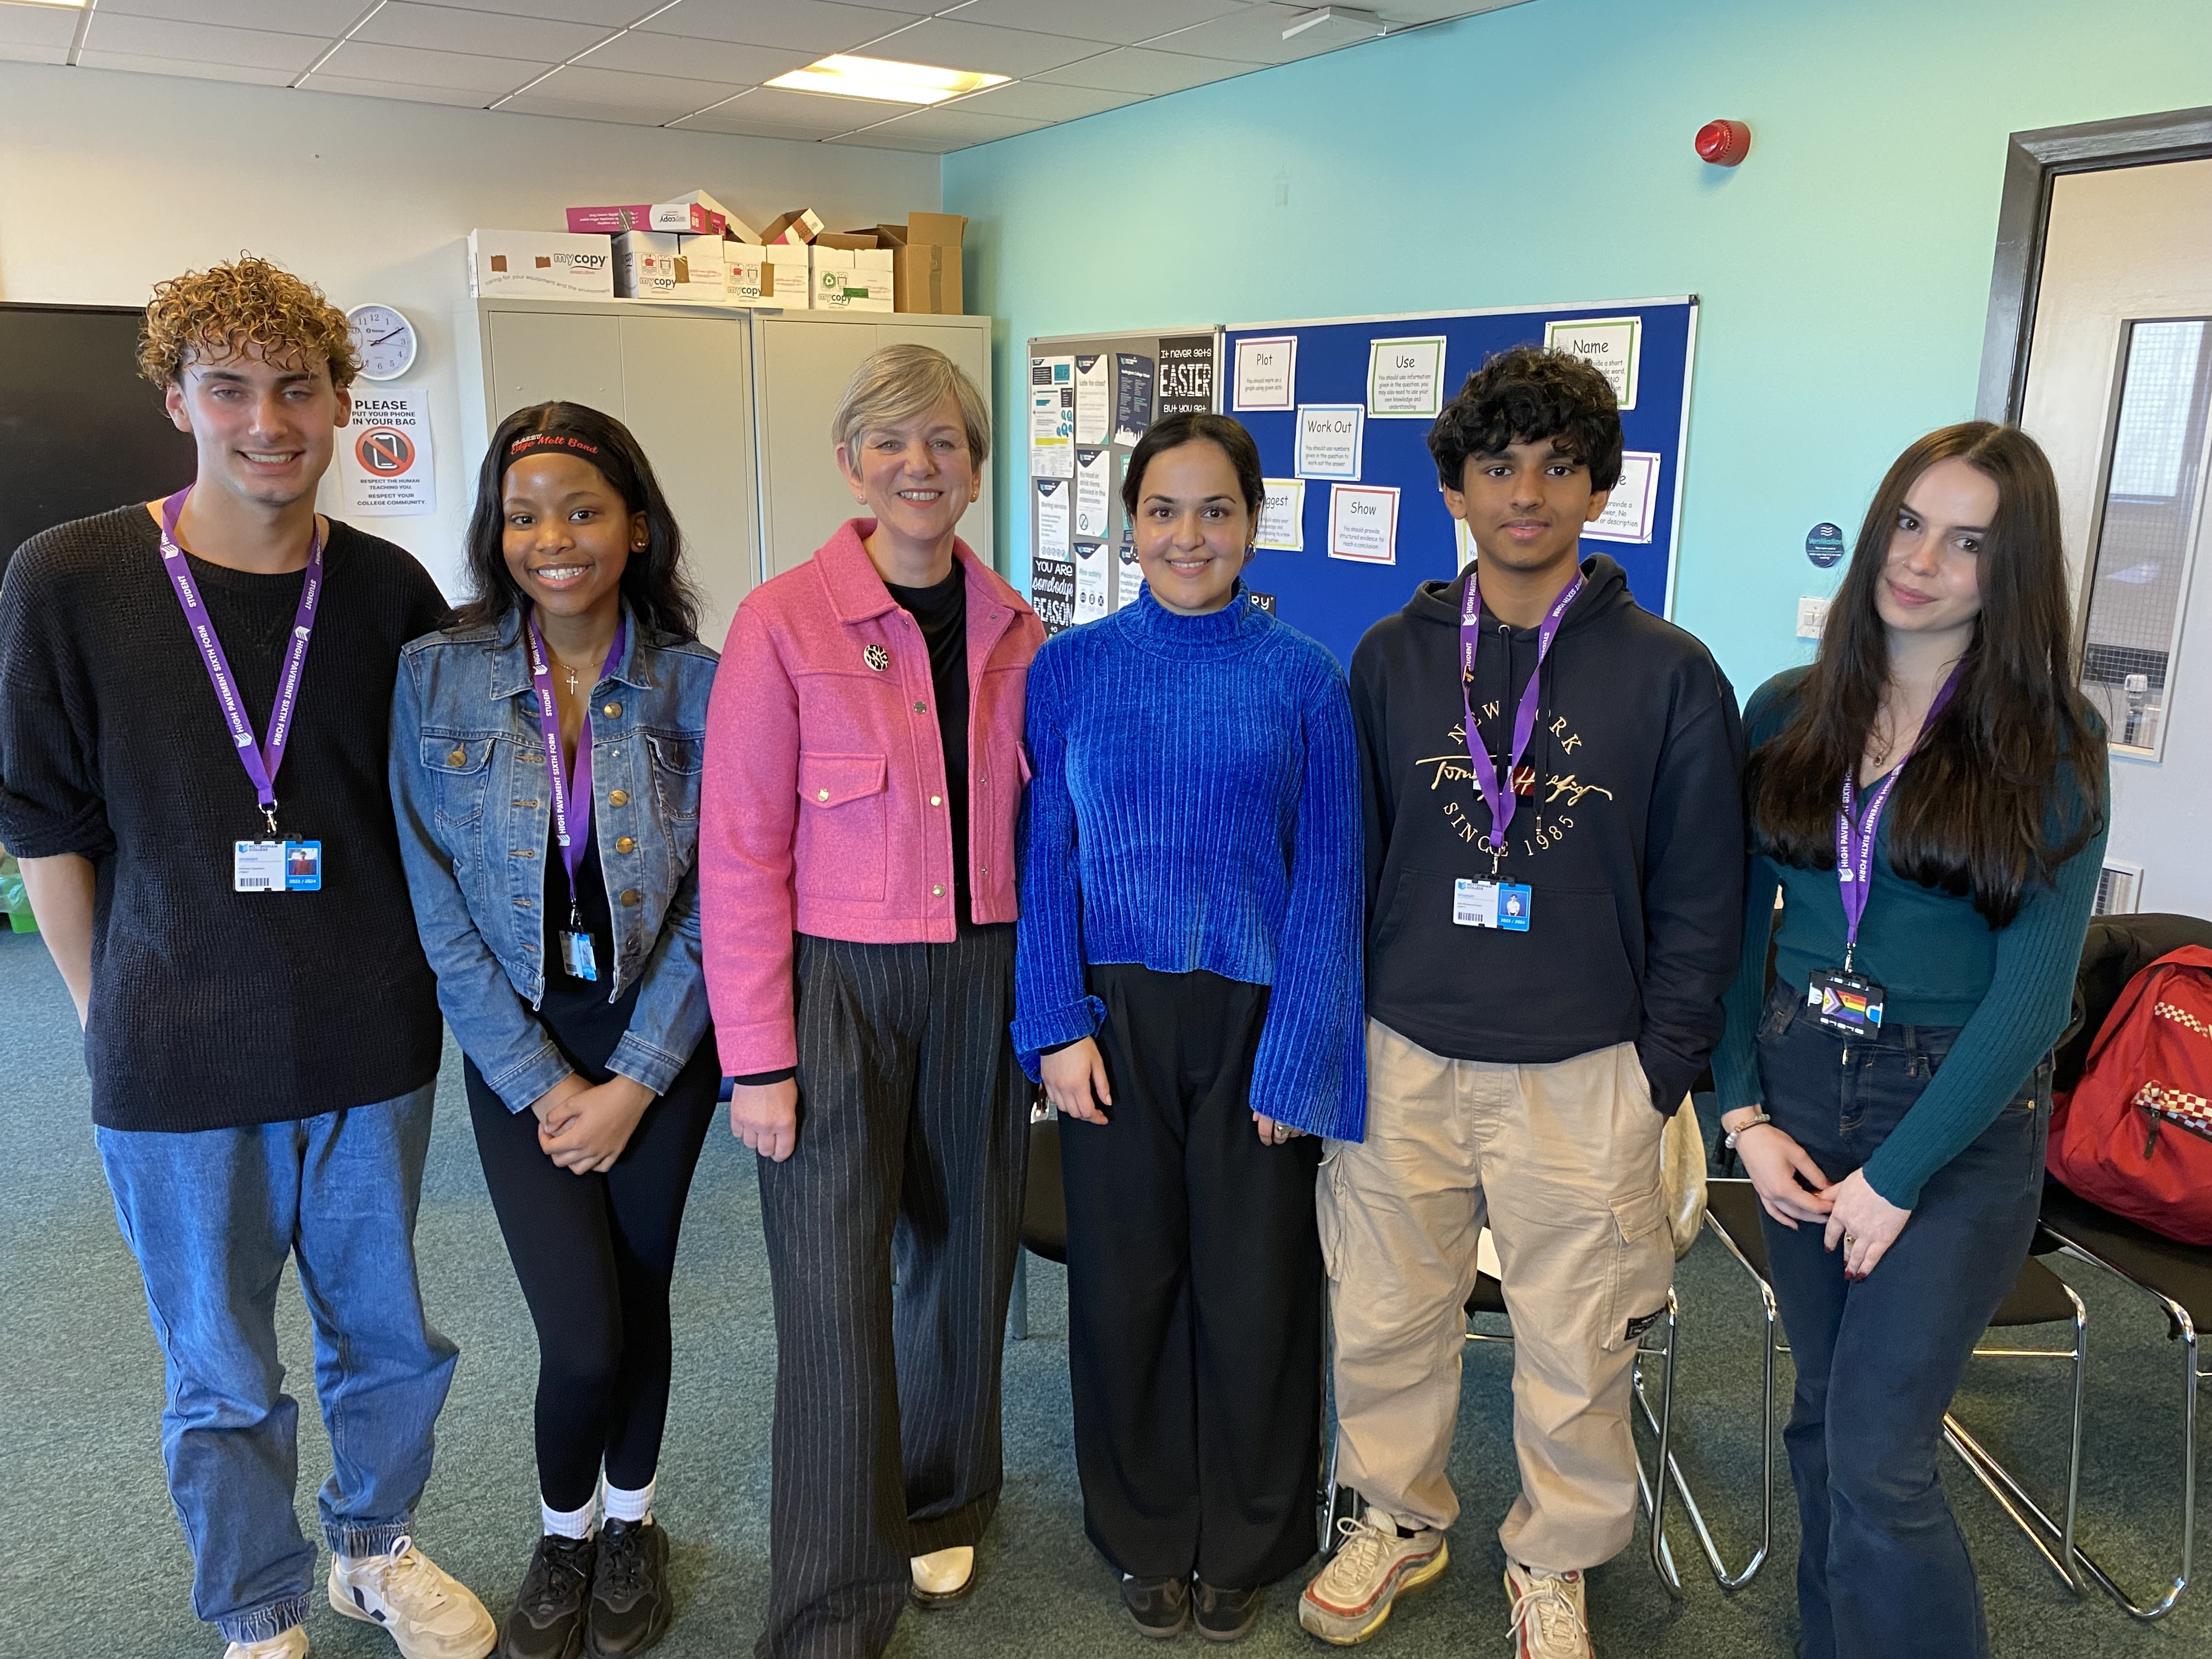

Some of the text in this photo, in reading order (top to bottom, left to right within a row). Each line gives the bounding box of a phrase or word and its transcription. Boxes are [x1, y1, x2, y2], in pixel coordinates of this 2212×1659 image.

[554, 253, 606, 268] mycopy
[486, 277, 501, 286] caring
[526, 275, 555, 285] equipment
[639, 277, 676, 288] mycopy
[1193, 348, 1212, 357] gets
[1573, 339, 1609, 354] Name
[1257, 353, 1273, 365] Plot
[1396, 356, 1415, 368] Use
[355, 400, 408, 410] PLEASE
[1308, 420, 1352, 433] Work Out
[538, 436, 565, 445] Melt
[567, 438, 598, 454] Band
[1266, 495, 1288, 509] ggest
[1351, 501, 1376, 515] Show
[1607, 518, 1638, 527] description
[161, 529, 170, 545] HIG
[1035, 560, 1053, 573] YOU
[177, 575, 197, 608] STUDENT
[304, 579, 317, 611] STUDENT
[1562, 588, 1577, 604] SIXTH
[1033, 596, 1073, 627] REASON
[1466, 597, 1474, 613] HIGH
[532, 650, 541, 665] HIGH
[197, 625, 244, 733] HIGH PAVEMENT SIXTH FORM
[272, 639, 304, 746] HIGH PAVEMENT SIXTH FORM
[541, 689, 552, 717] STUDENT
[548, 733, 566, 834] HIGH PAVEMENT SIXTH FORM
[1840, 782, 1852, 868] HIGH SIXTH
[1858, 776, 1895, 883] HIGH PAVEMENT SIXTH FORM
[1523, 815, 1574, 856] 1985
